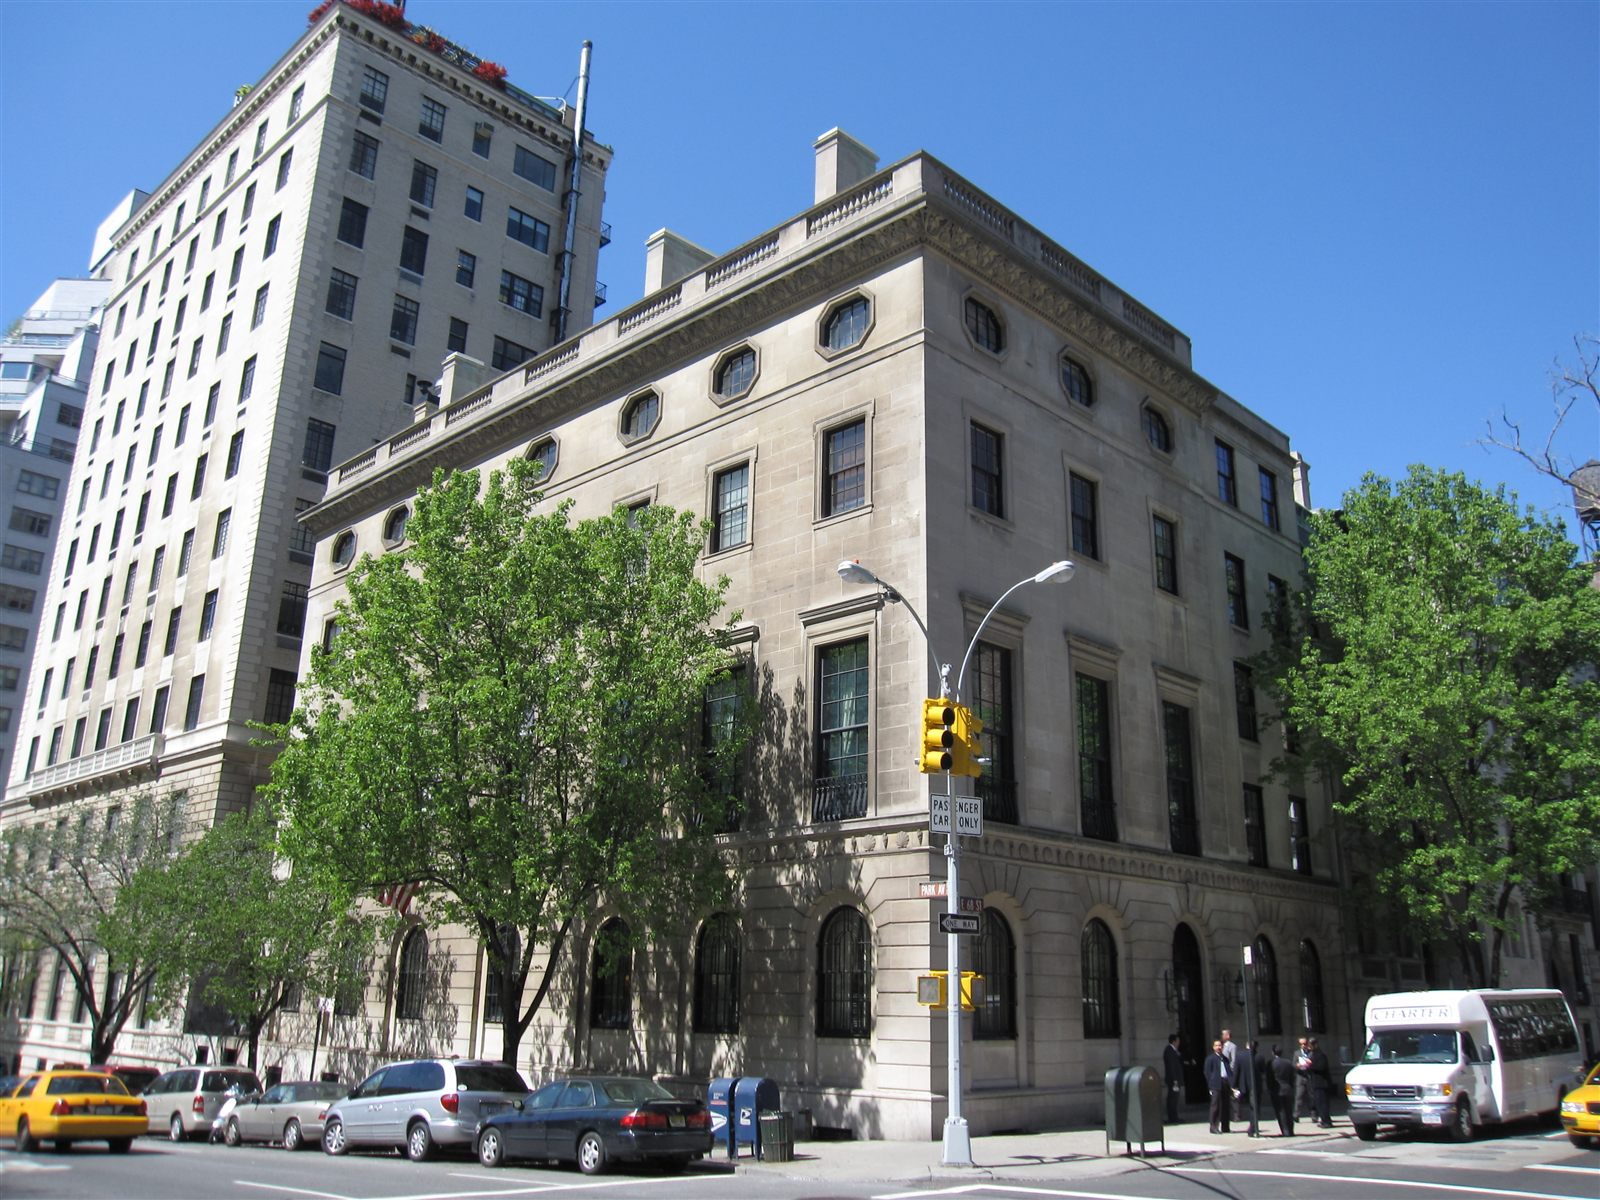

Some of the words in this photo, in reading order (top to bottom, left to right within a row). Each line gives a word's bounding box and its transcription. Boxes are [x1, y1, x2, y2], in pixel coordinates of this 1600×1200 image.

[933, 799, 979, 815] PASNGER
[933, 814, 952, 828] CAR
[959, 816, 979, 829] ONLY
[921, 883, 935, 897] PARK
[945, 919, 958, 928] ONE
[962, 920, 975, 929] WAY
[1374, 1008, 1448, 1020] CHARTER
